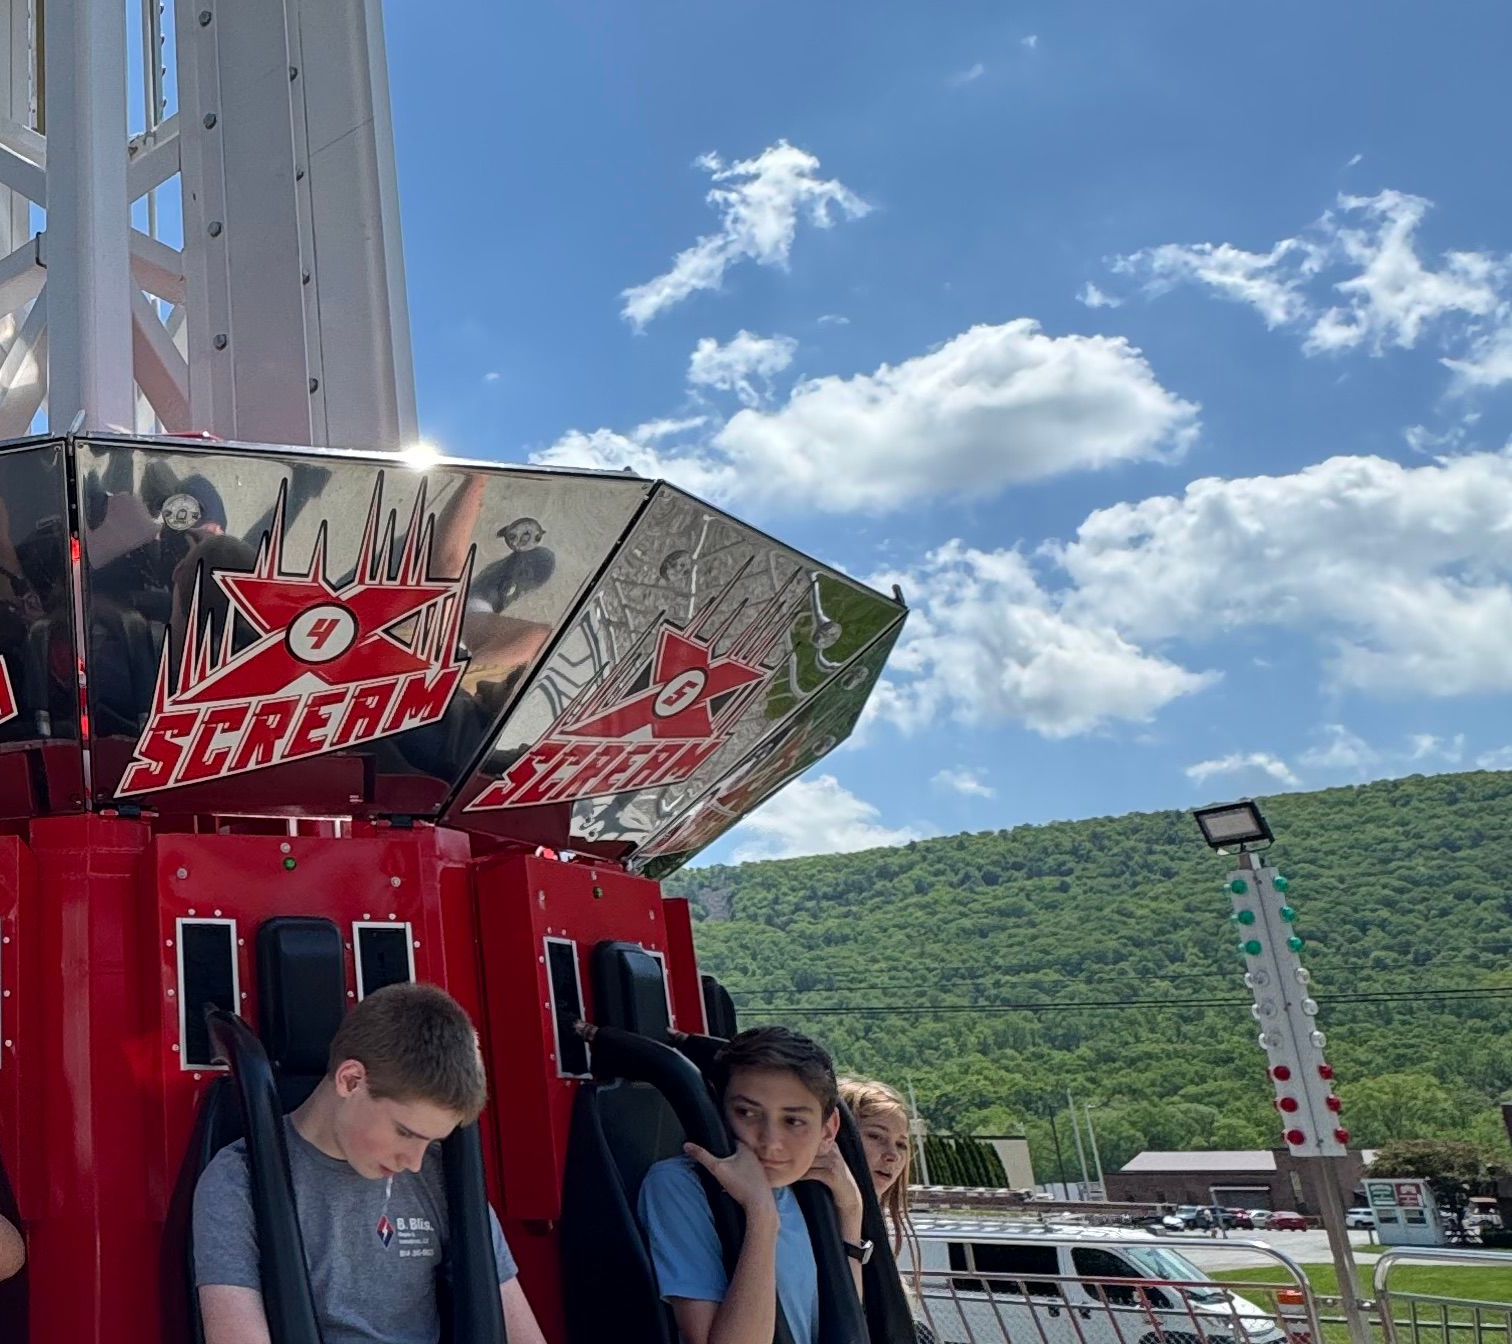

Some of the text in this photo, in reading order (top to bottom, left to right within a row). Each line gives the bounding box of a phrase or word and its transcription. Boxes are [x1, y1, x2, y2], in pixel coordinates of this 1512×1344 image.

[306, 618, 341, 650] 4
[661, 679, 699, 707] 5
[120, 666, 463, 795] SCREAM
[469, 740, 724, 809] SCREAM
